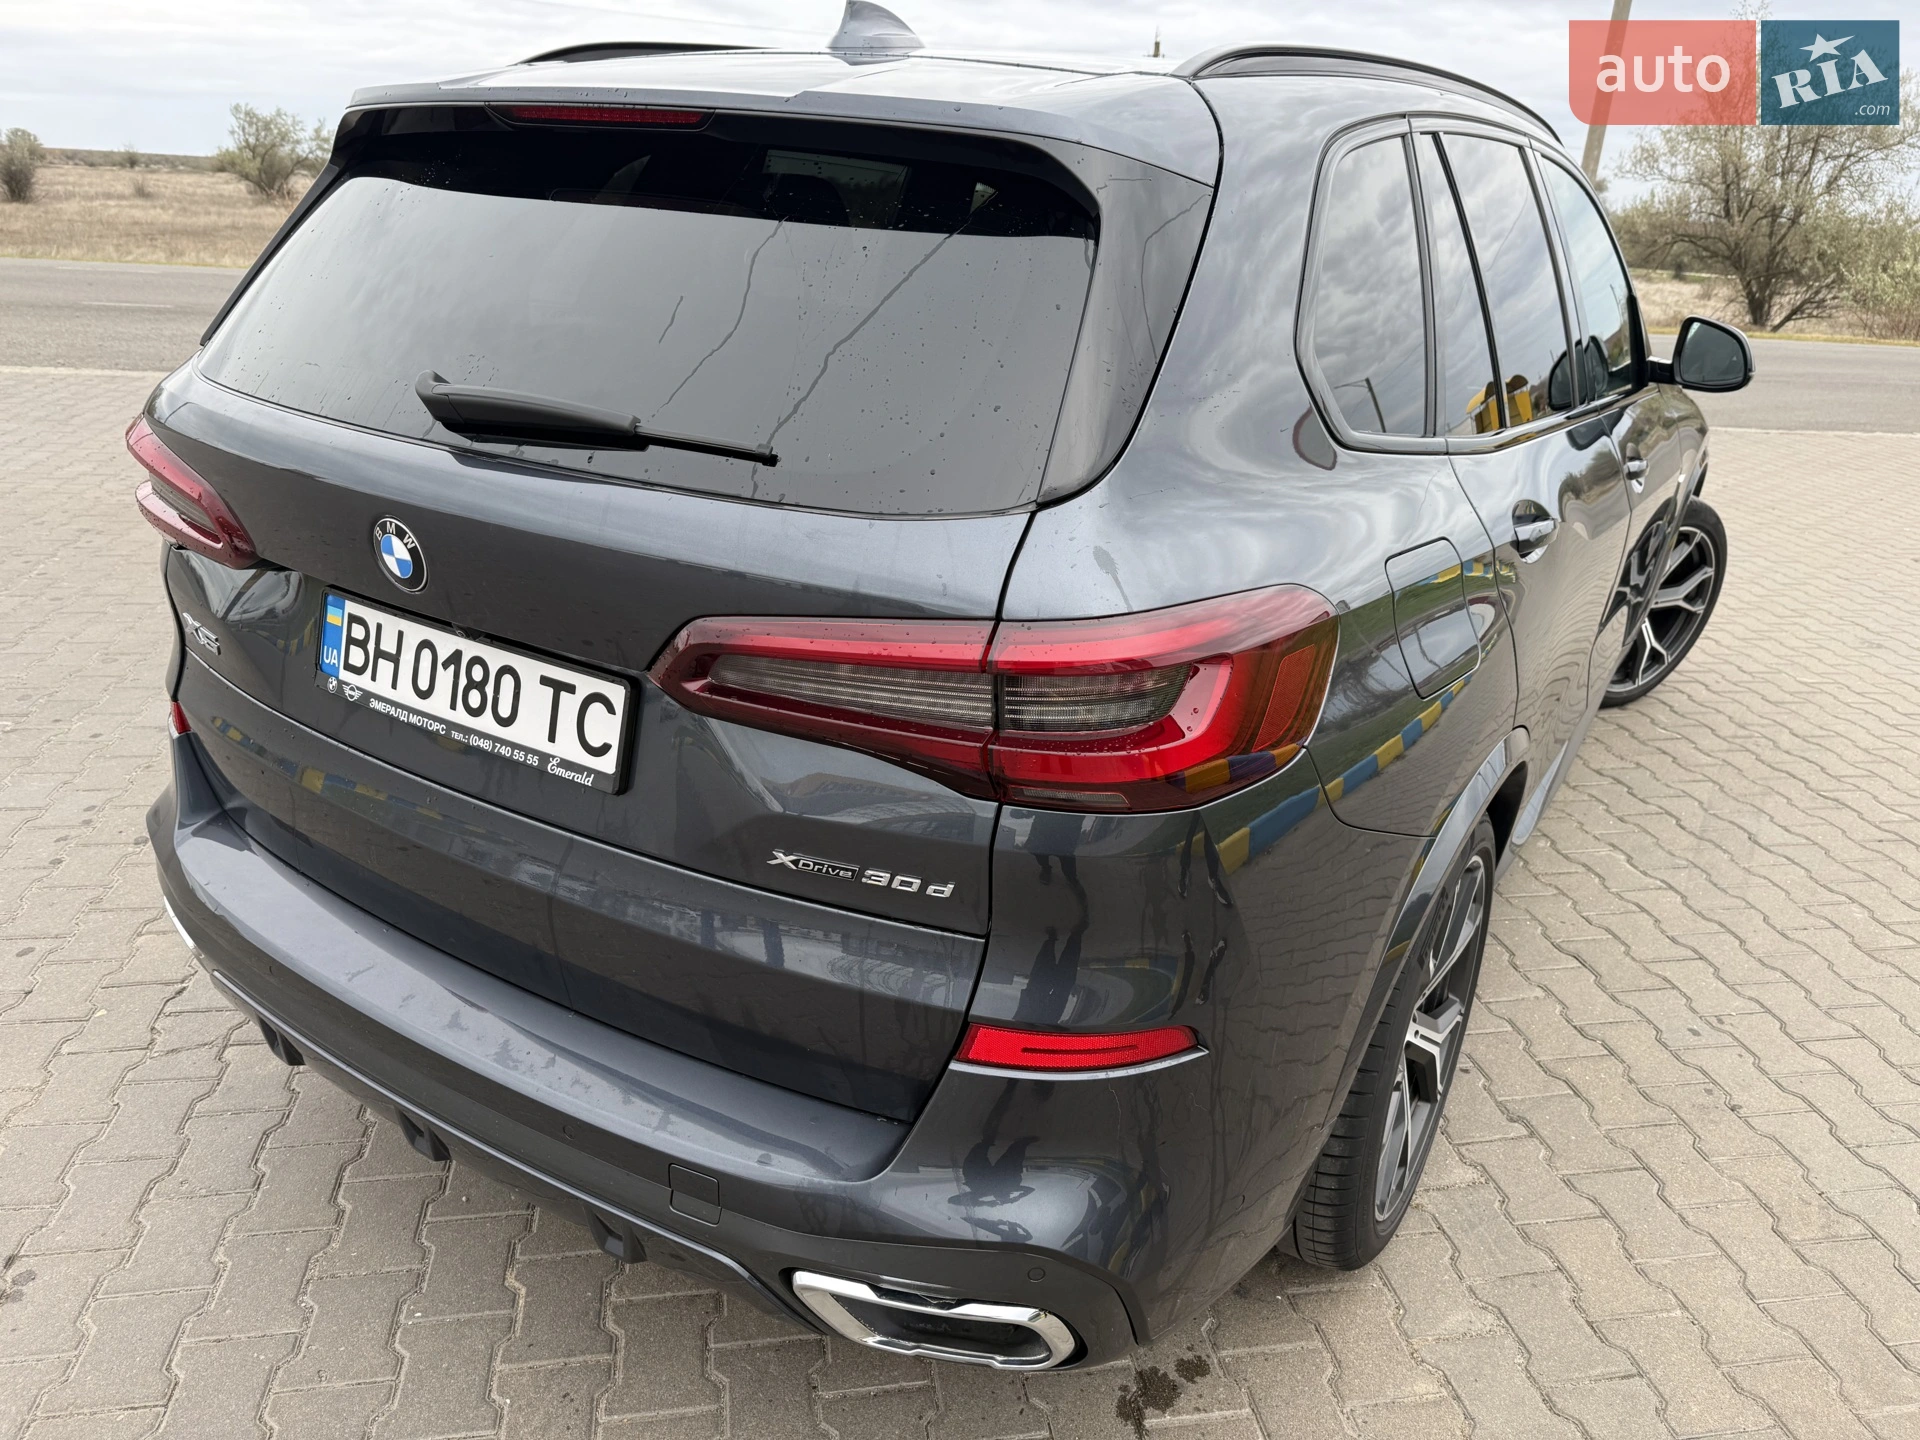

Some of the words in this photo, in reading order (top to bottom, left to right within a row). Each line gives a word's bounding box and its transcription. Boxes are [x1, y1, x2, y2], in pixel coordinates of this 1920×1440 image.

[375, 521, 416, 550] BMW
[182, 611, 222, 656] X5
[323, 645, 339, 668] UA
[342, 611, 405, 691] BH
[411, 638, 522, 728] 0180
[539, 674, 617, 758] TC
[369, 698, 408, 723] ЭМЕРАЛД
[409, 712, 447, 735] МОТОРС
[469, 733, 493, 753] (048)
[494, 742, 512, 757] 740
[512, 750, 526, 762] 55
[526, 753, 540, 766] 55
[547, 756, 595, 787] Emerald
